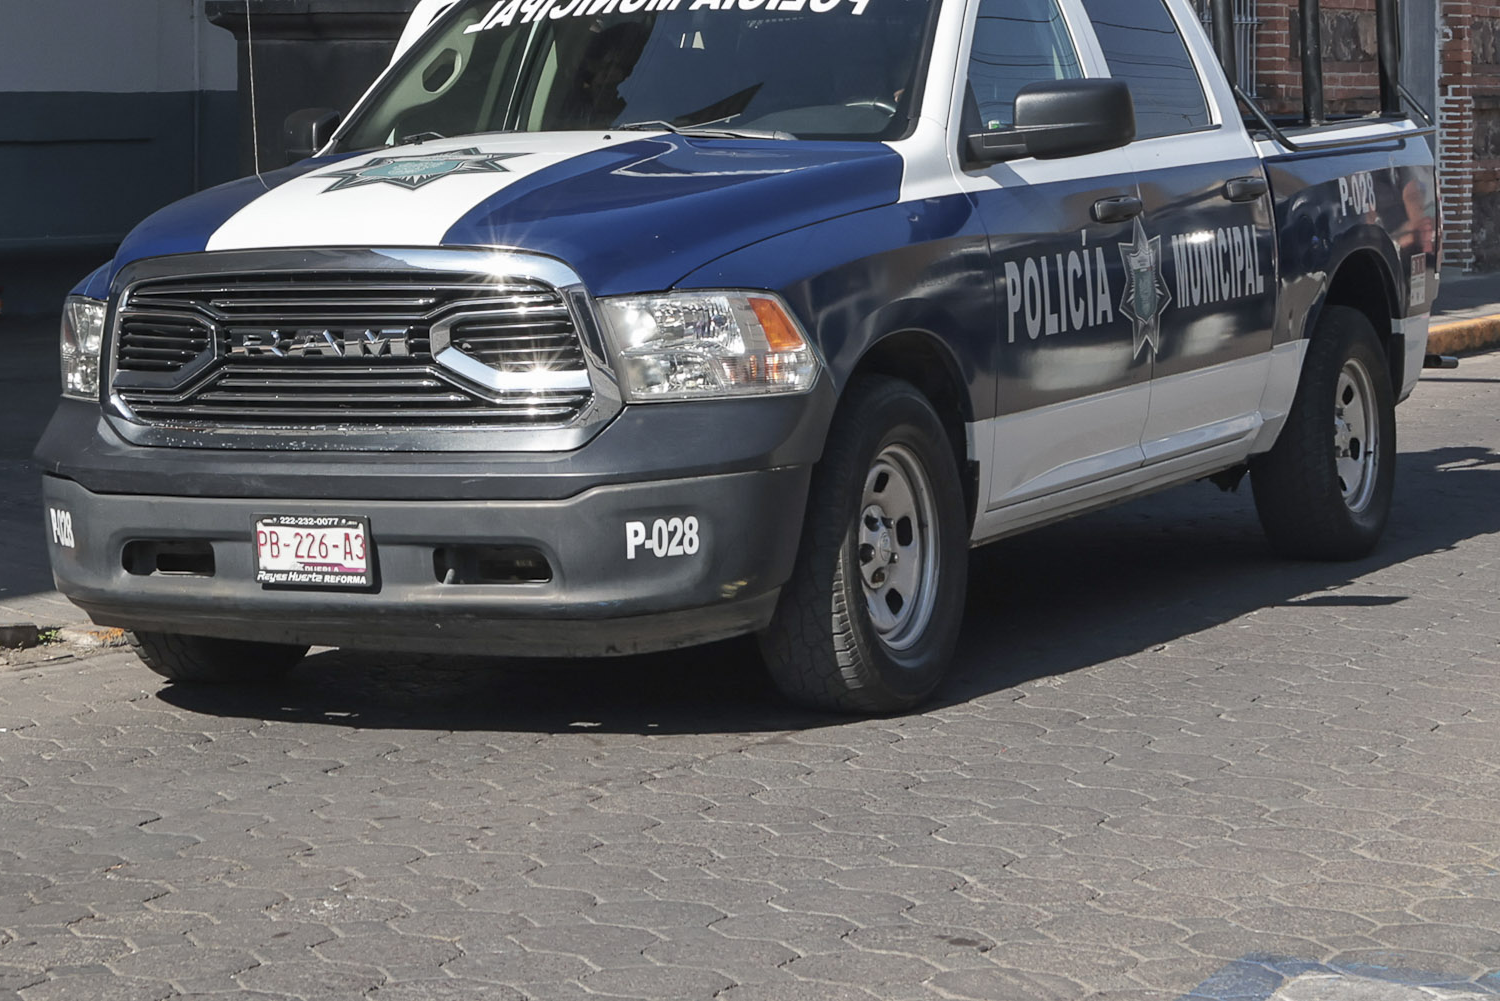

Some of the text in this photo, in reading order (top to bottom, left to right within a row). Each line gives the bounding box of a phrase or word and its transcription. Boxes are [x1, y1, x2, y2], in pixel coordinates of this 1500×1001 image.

[1338, 172, 1376, 217] P-028
[1004, 224, 1265, 343] POLICÍA MUNICIPAL
[232, 329, 408, 357] RAM
[49, 507, 75, 549] P-028
[279, 516, 339, 526] 222-232-0077
[626, 515, 700, 560] P-028
[256, 530, 366, 561] PB-226-A3
[257, 571, 288, 583] Reyes
[323, 574, 367, 585] REFORMA
